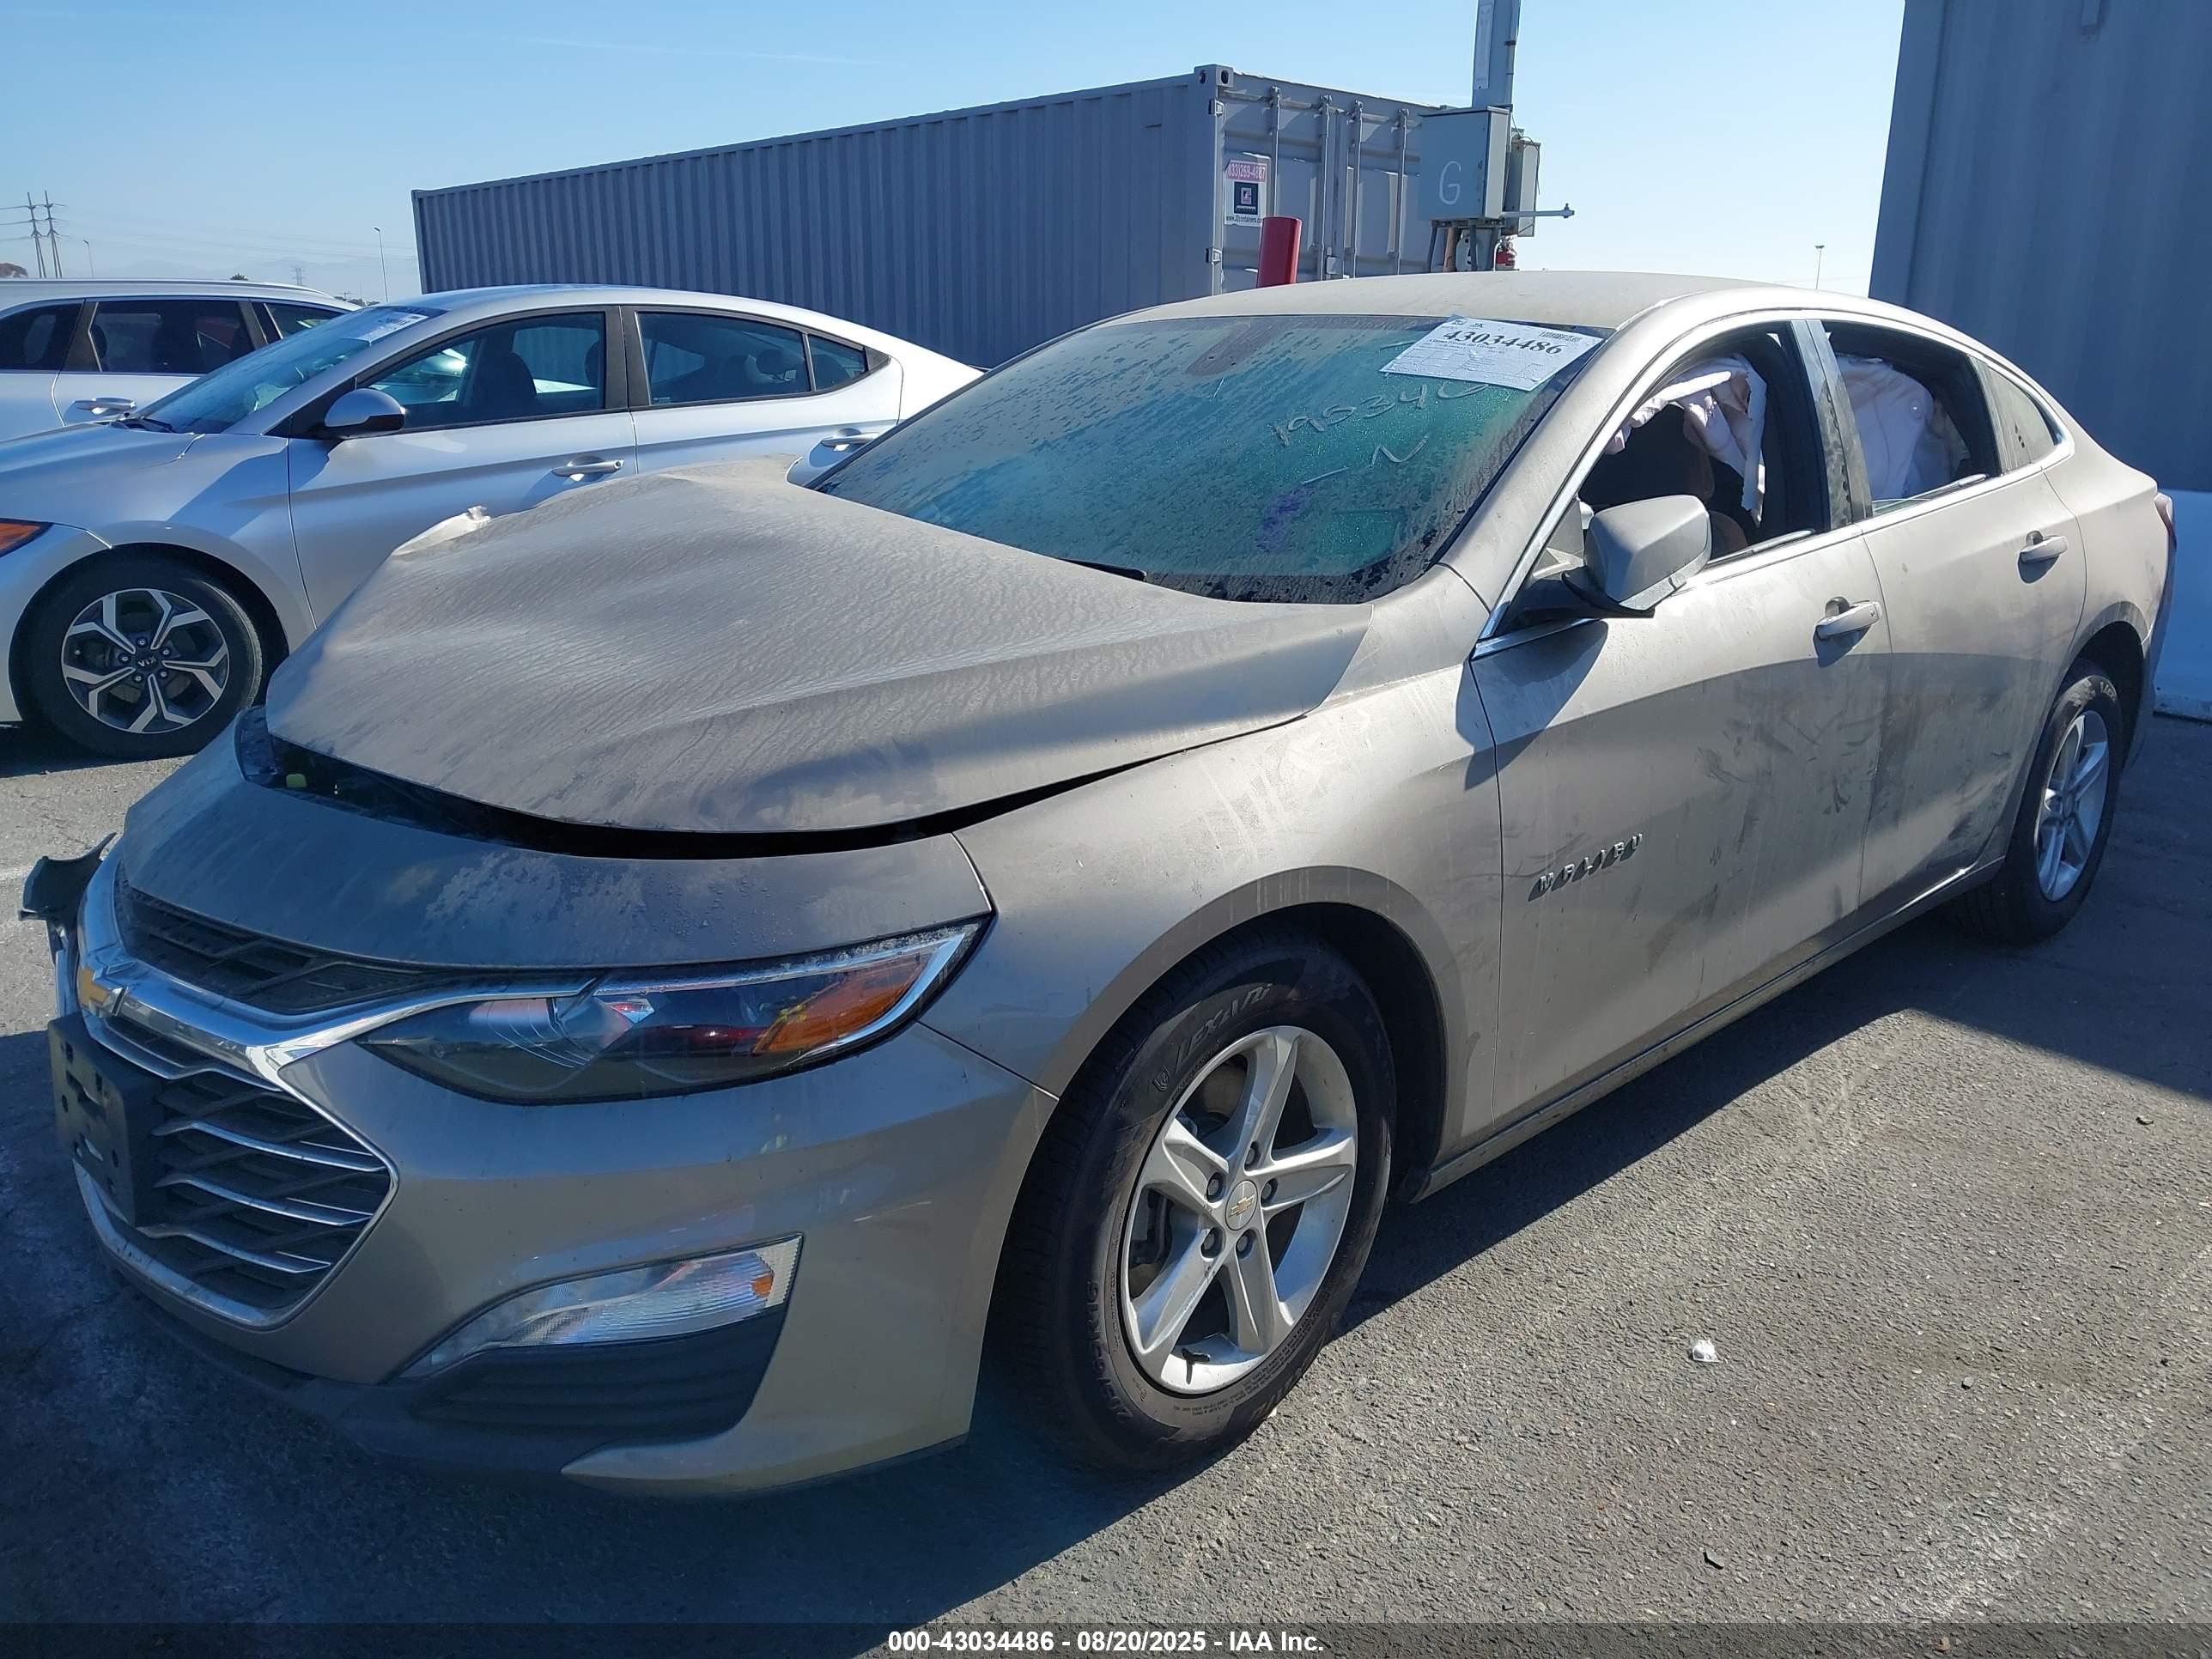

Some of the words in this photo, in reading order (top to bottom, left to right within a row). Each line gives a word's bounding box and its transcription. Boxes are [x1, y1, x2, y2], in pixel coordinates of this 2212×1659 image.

[1439, 161, 1462, 205] G
[1443, 330, 1563, 356] 43034486
[1537, 832, 1643, 892] MALIBU
